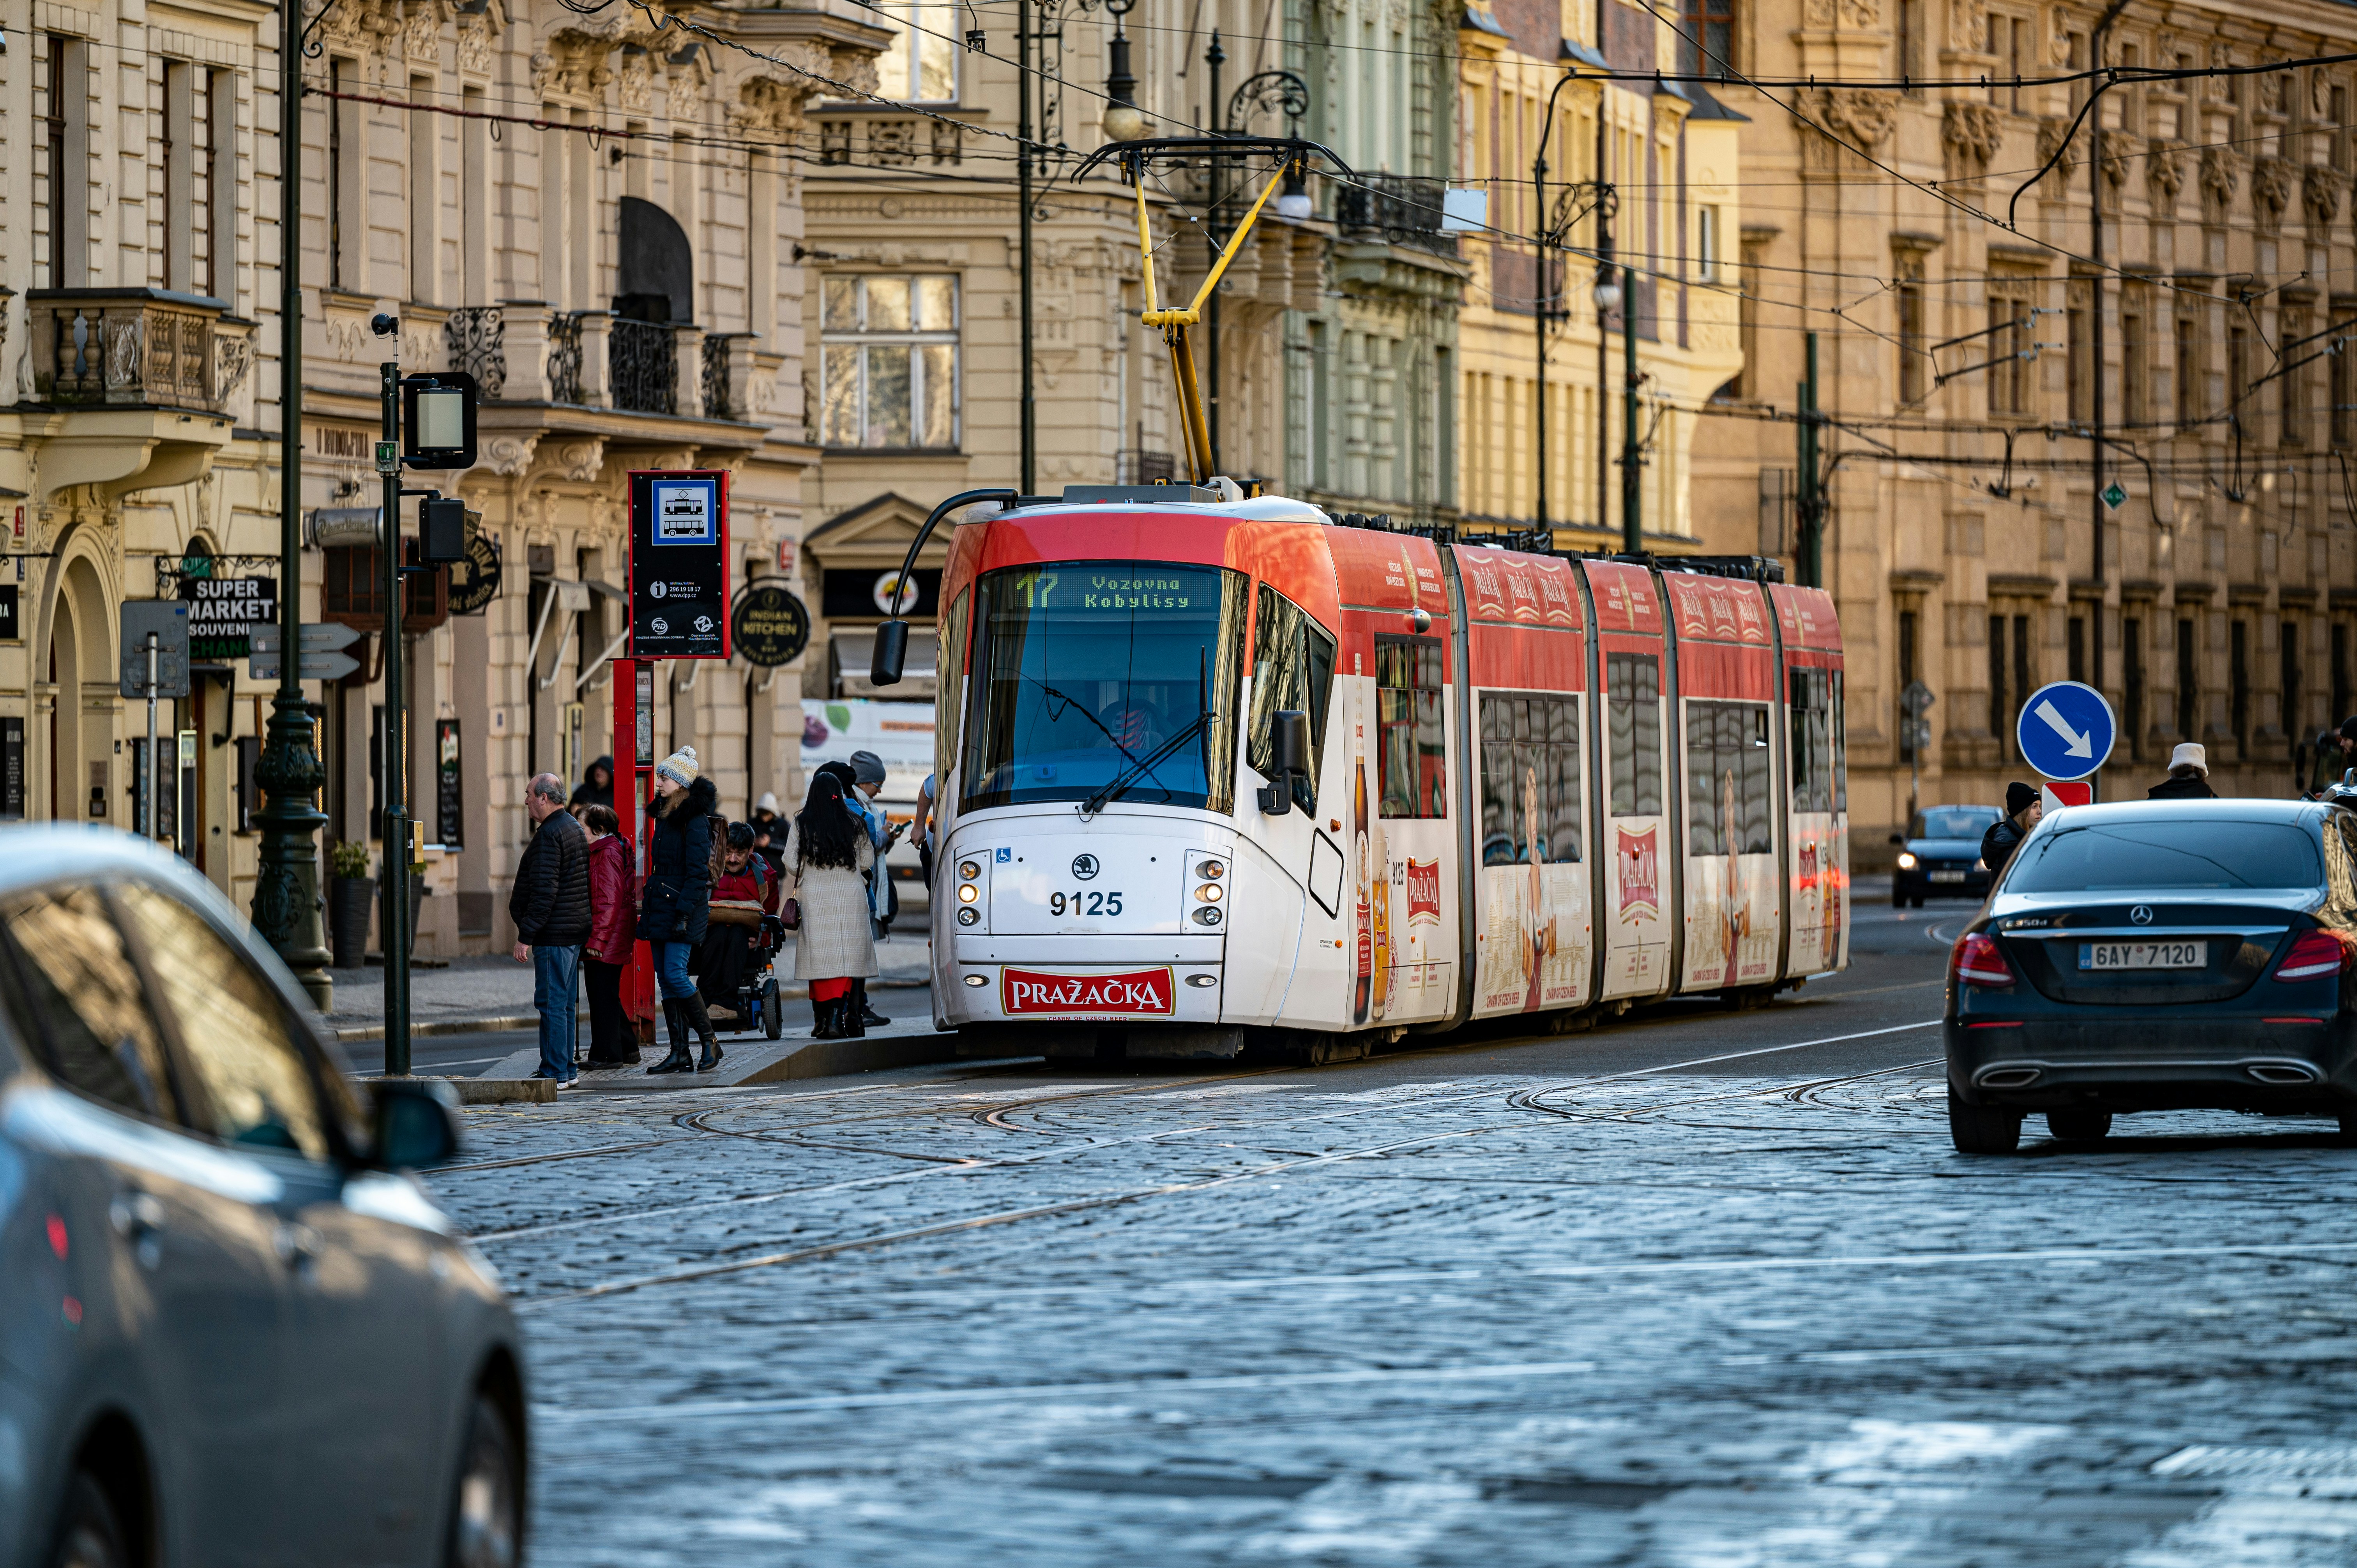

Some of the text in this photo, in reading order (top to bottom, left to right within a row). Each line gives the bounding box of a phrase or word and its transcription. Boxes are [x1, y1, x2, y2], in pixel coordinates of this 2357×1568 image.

[196, 580, 259, 599] SUPER
[1016, 573, 1058, 607] 17
[1092, 577, 1180, 590] Vozovna
[1473, 567, 1502, 604] PRAŽAČKA
[1507, 570, 1537, 607] PRAŽAČKA
[1540, 574, 1570, 611] PRAŽAČKA
[189, 599, 274, 620] MARKET
[1085, 594, 1188, 607] Kobylisy
[749, 609, 792, 622] INDIAN
[189, 622, 250, 636] SOUVENI
[742, 622, 797, 636] KITCHEN
[189, 640, 251, 658] CHAN
[1392, 861, 1404, 886] 9125
[1620, 842, 1657, 901] PRAŽAČKA
[1408, 871, 1438, 911] PRAŽAČKA
[1050, 891, 1123, 916] 9125
[2096, 945, 2196, 966] 6AY 7120
[1010, 979, 1166, 1010] PRAŽAČKA
[1486, 991, 1520, 1008] CHARM OF CZECH BEER
[1546, 987, 1556, 1001] CHARM
[1556, 987, 1560, 1000] OF
[1560, 986, 1569, 999] CZECH
